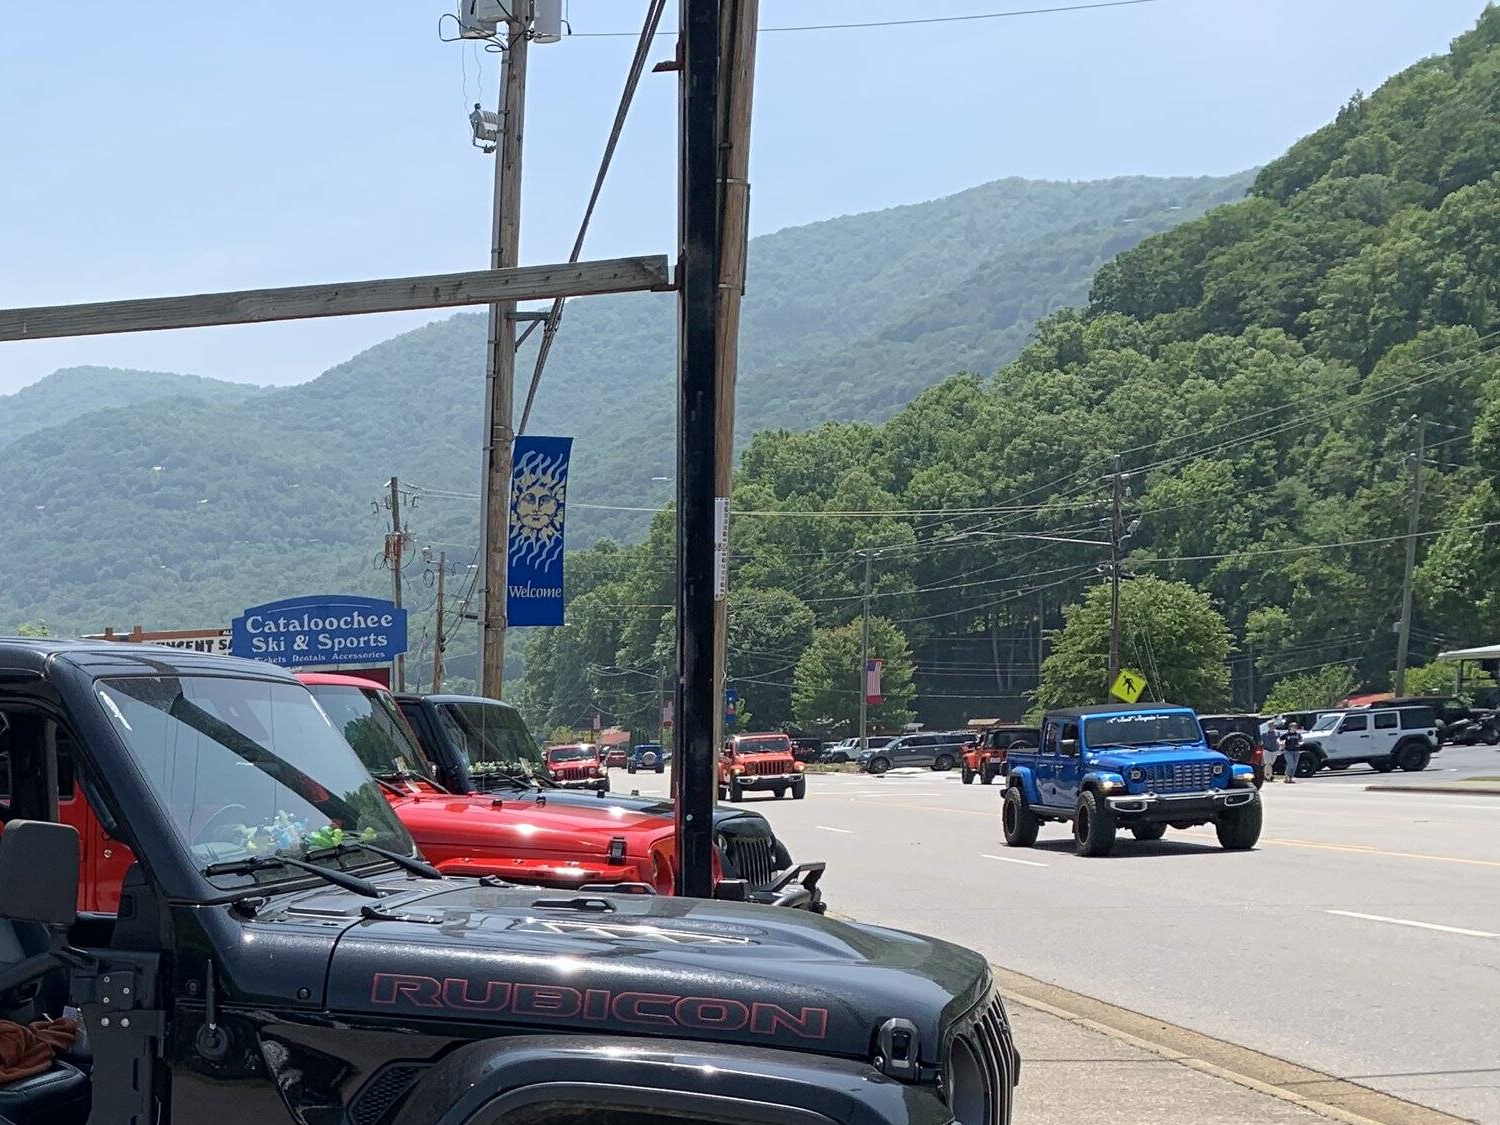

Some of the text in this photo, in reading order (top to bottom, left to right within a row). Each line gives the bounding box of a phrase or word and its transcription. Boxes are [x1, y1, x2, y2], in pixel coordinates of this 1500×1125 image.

[508, 580, 562, 598] Welcome
[245, 611, 393, 634] Cataloochee
[251, 632, 388, 653] Ski & Sports
[292, 653, 326, 663] Rentals
[331, 650, 386, 661] Accessories
[371, 972, 828, 1039] RUBICON
